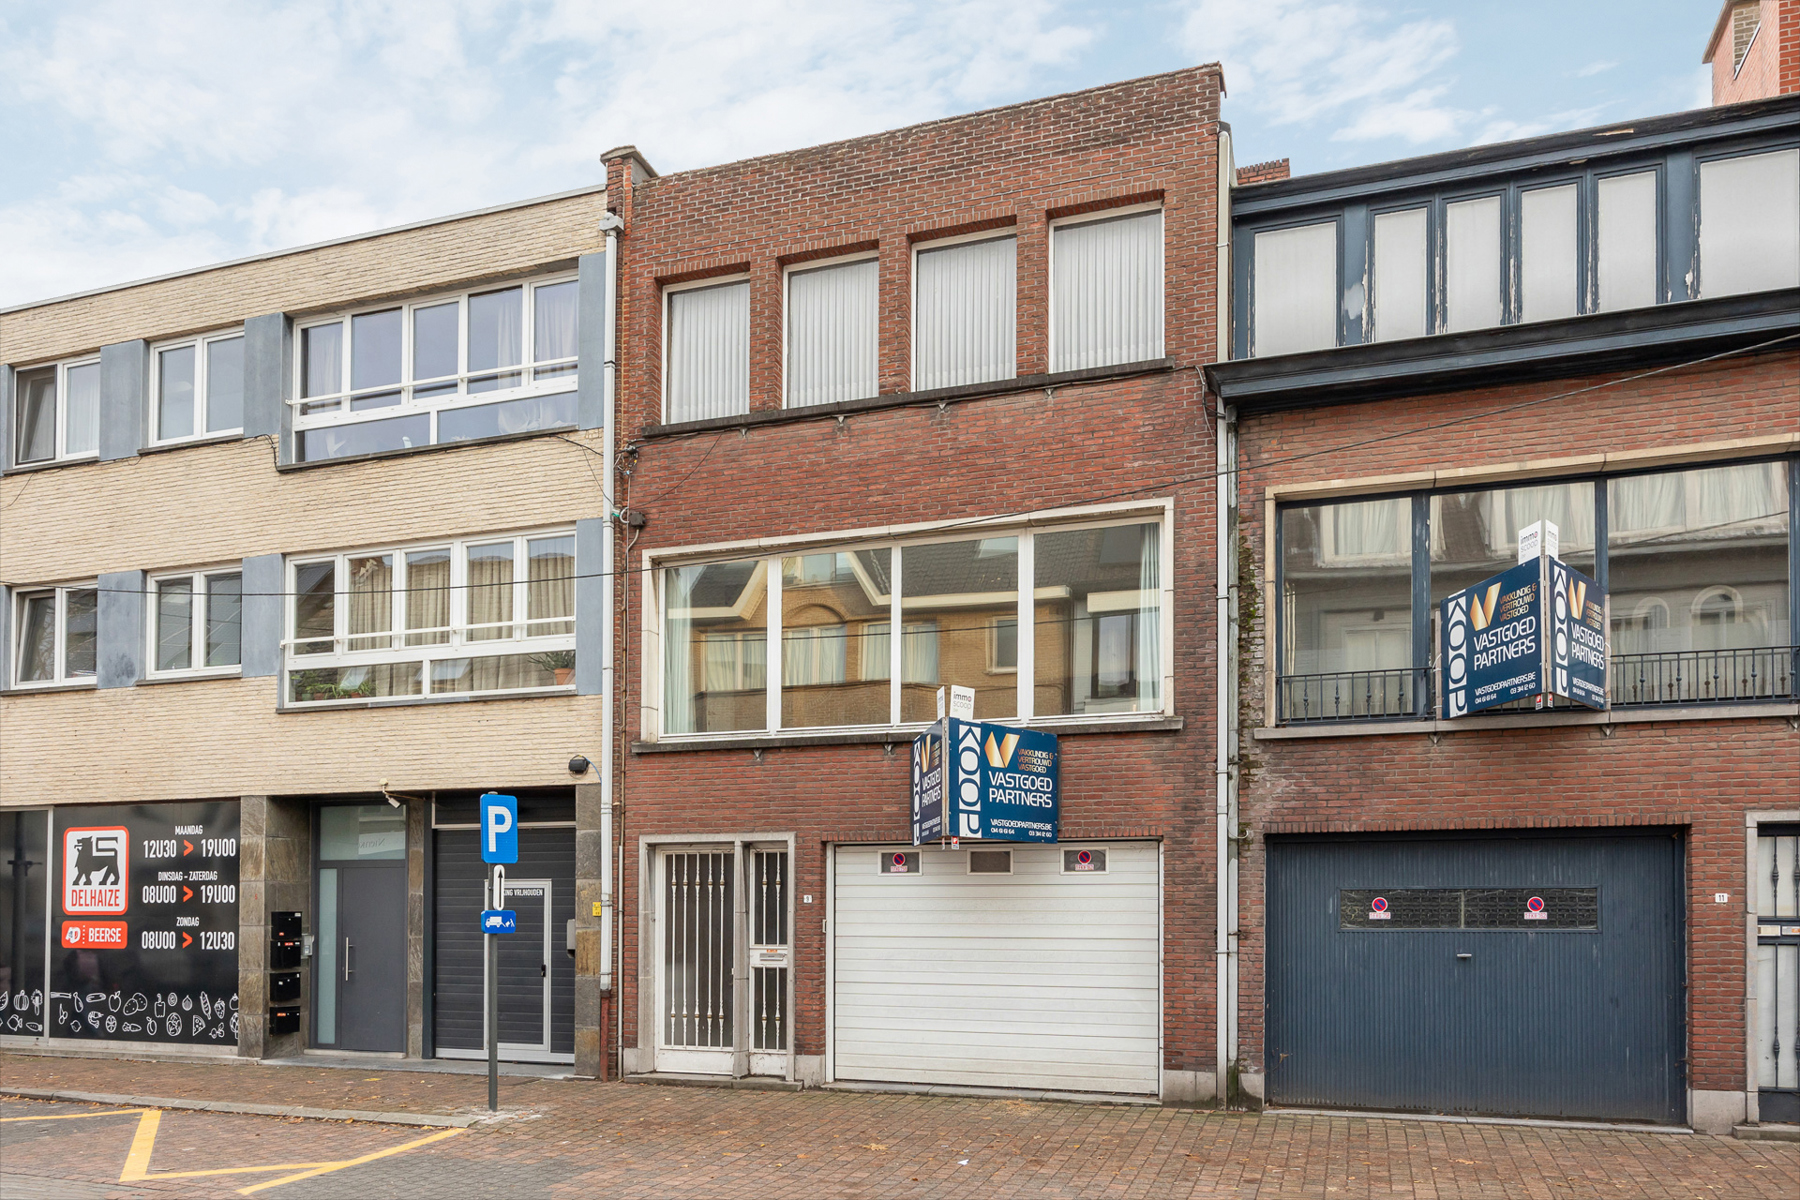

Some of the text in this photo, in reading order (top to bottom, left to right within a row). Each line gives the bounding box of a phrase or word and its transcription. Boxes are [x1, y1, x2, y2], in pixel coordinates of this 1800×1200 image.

[1521, 531, 1538, 544] immo
[1500, 585, 1531, 604] VAKKUNDIG
[1500, 593, 1535, 613] VERTROUWD
[1500, 604, 1529, 622] VASTGOED
[1474, 615, 1535, 651] VASTGOED
[1571, 621, 1604, 651] VASTGOED
[1474, 636, 1535, 670] PARTNERS
[1571, 641, 1604, 670] PARTNERS
[953, 692, 972, 702] immo
[1018, 748, 1048, 759] VAKKUNDIG
[1018, 756, 1052, 766] VERTROUWD
[1018, 763, 1047, 773] VASTGOED
[922, 767, 941, 790] VASTGOED
[989, 771, 1052, 791] VASTGOED
[922, 785, 941, 807] PARTNERS
[989, 788, 1052, 808] PARTNERS
[175, 825, 203, 835] MAANDAG
[488, 806, 512, 852] P
[990, 819, 1052, 830] VASTGOEDPARTNERS.BE
[143, 839, 236, 858] 12U30 19U00
[158, 871, 183, 881] DINSDAG
[189, 870, 217, 880] ZATERDAG
[71, 889, 120, 907] DELHAIZE
[142, 885, 235, 903] 08U00 19U00
[176, 917, 199, 927] ZONDAG
[89, 928, 121, 942] BEERSE
[142, 931, 234, 950] 08U00 12U30
